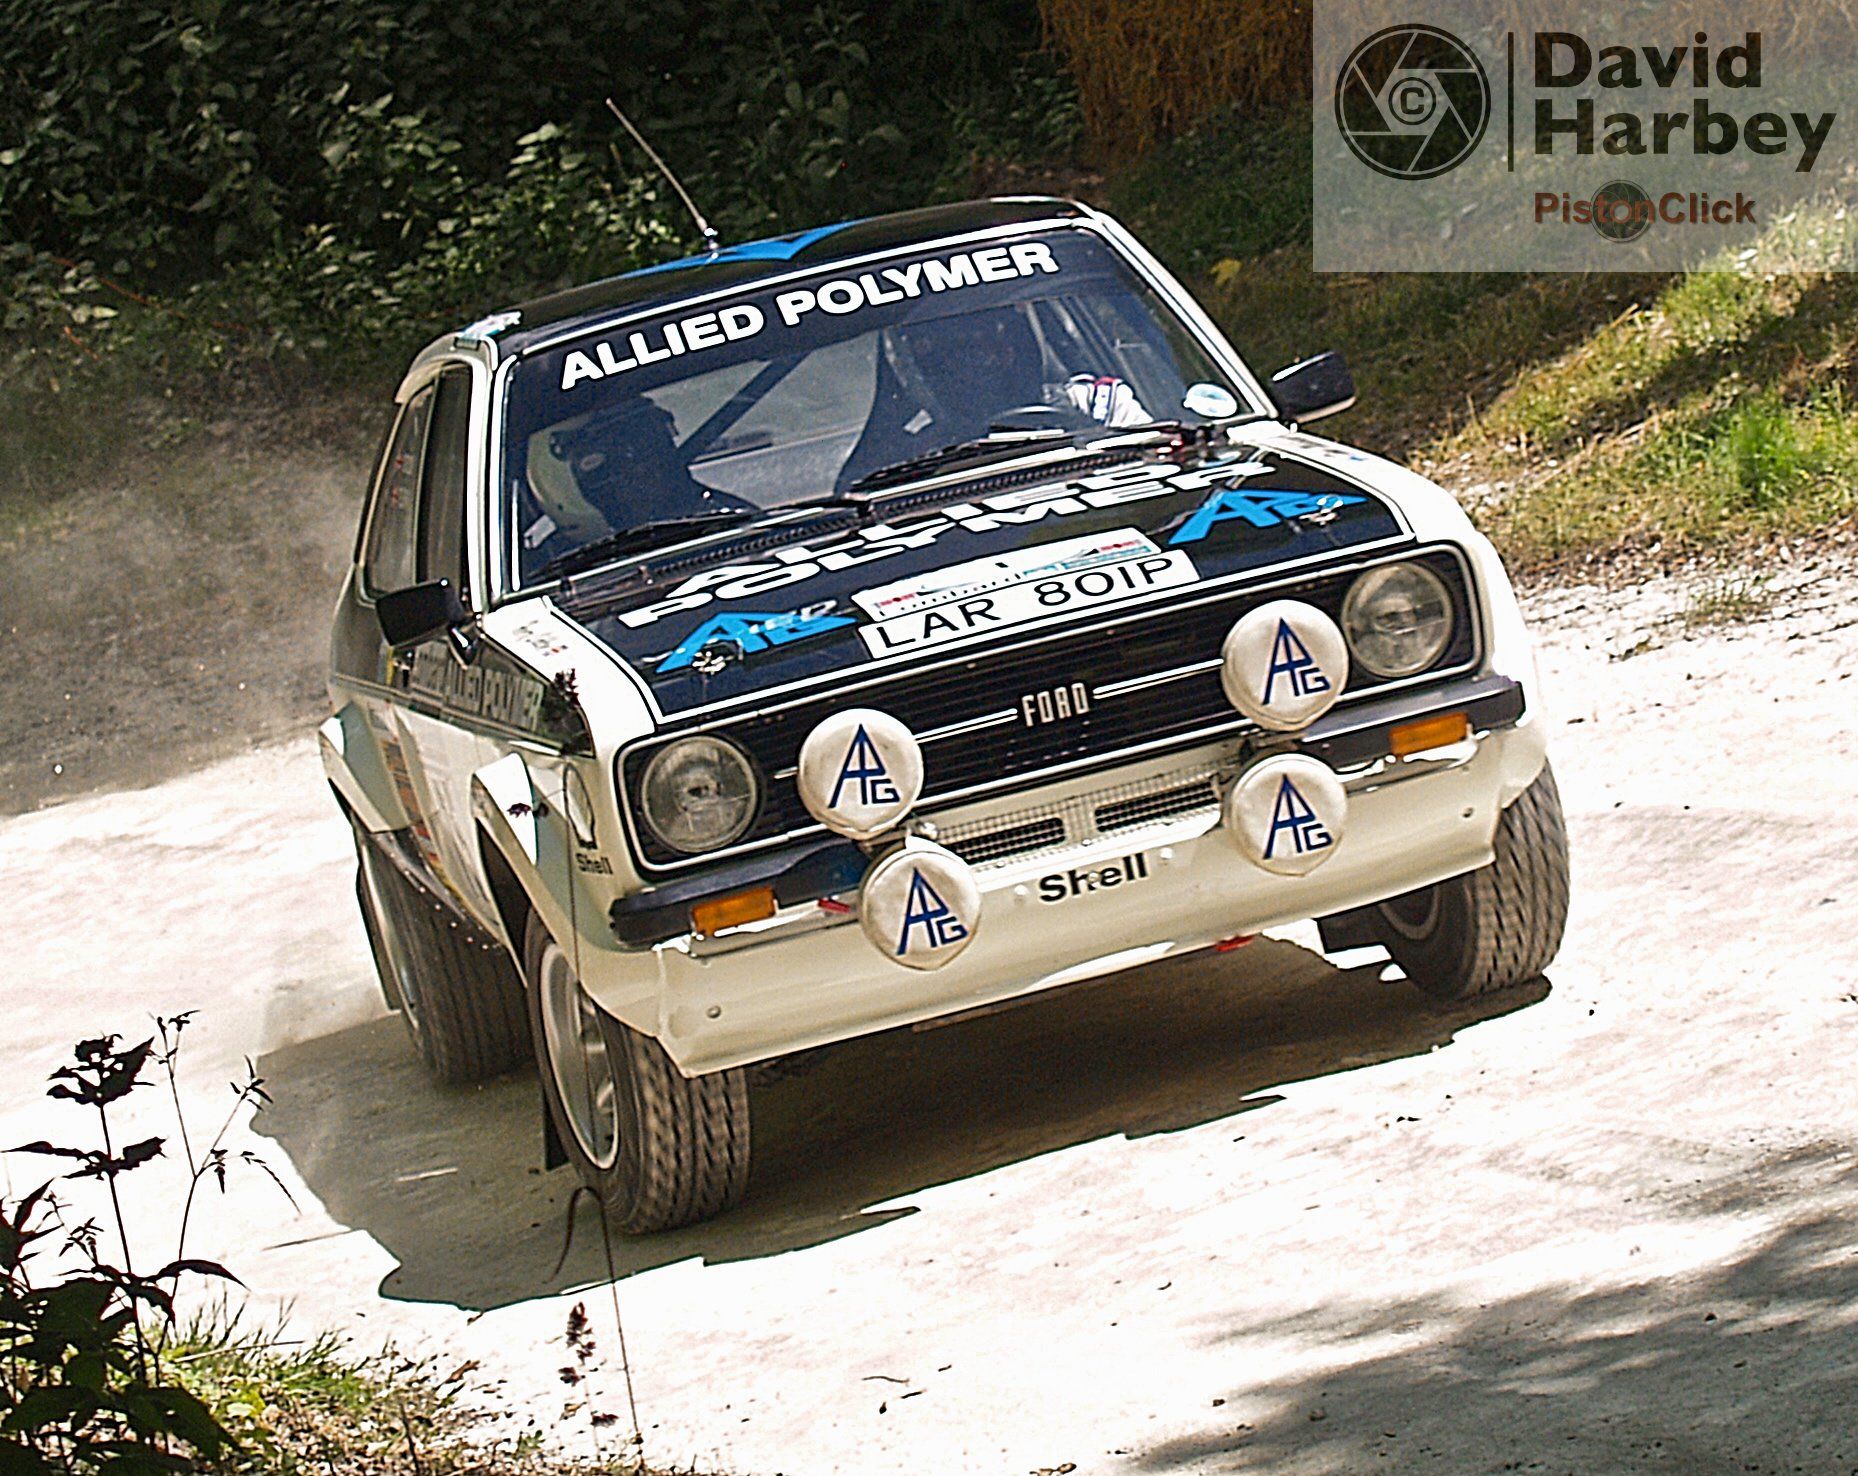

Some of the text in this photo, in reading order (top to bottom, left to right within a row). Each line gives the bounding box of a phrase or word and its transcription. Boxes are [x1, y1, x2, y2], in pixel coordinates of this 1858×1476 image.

[561, 241, 1060, 391] ALLIED POLYMER
[618, 461, 1276, 629] POLYMER
[876, 598, 1002, 649] LAR
[1033, 557, 1173, 607] 801P
[1021, 682, 1090, 727] FORD
[575, 852, 614, 875] Shell
[1039, 852, 1148, 902] Shell
